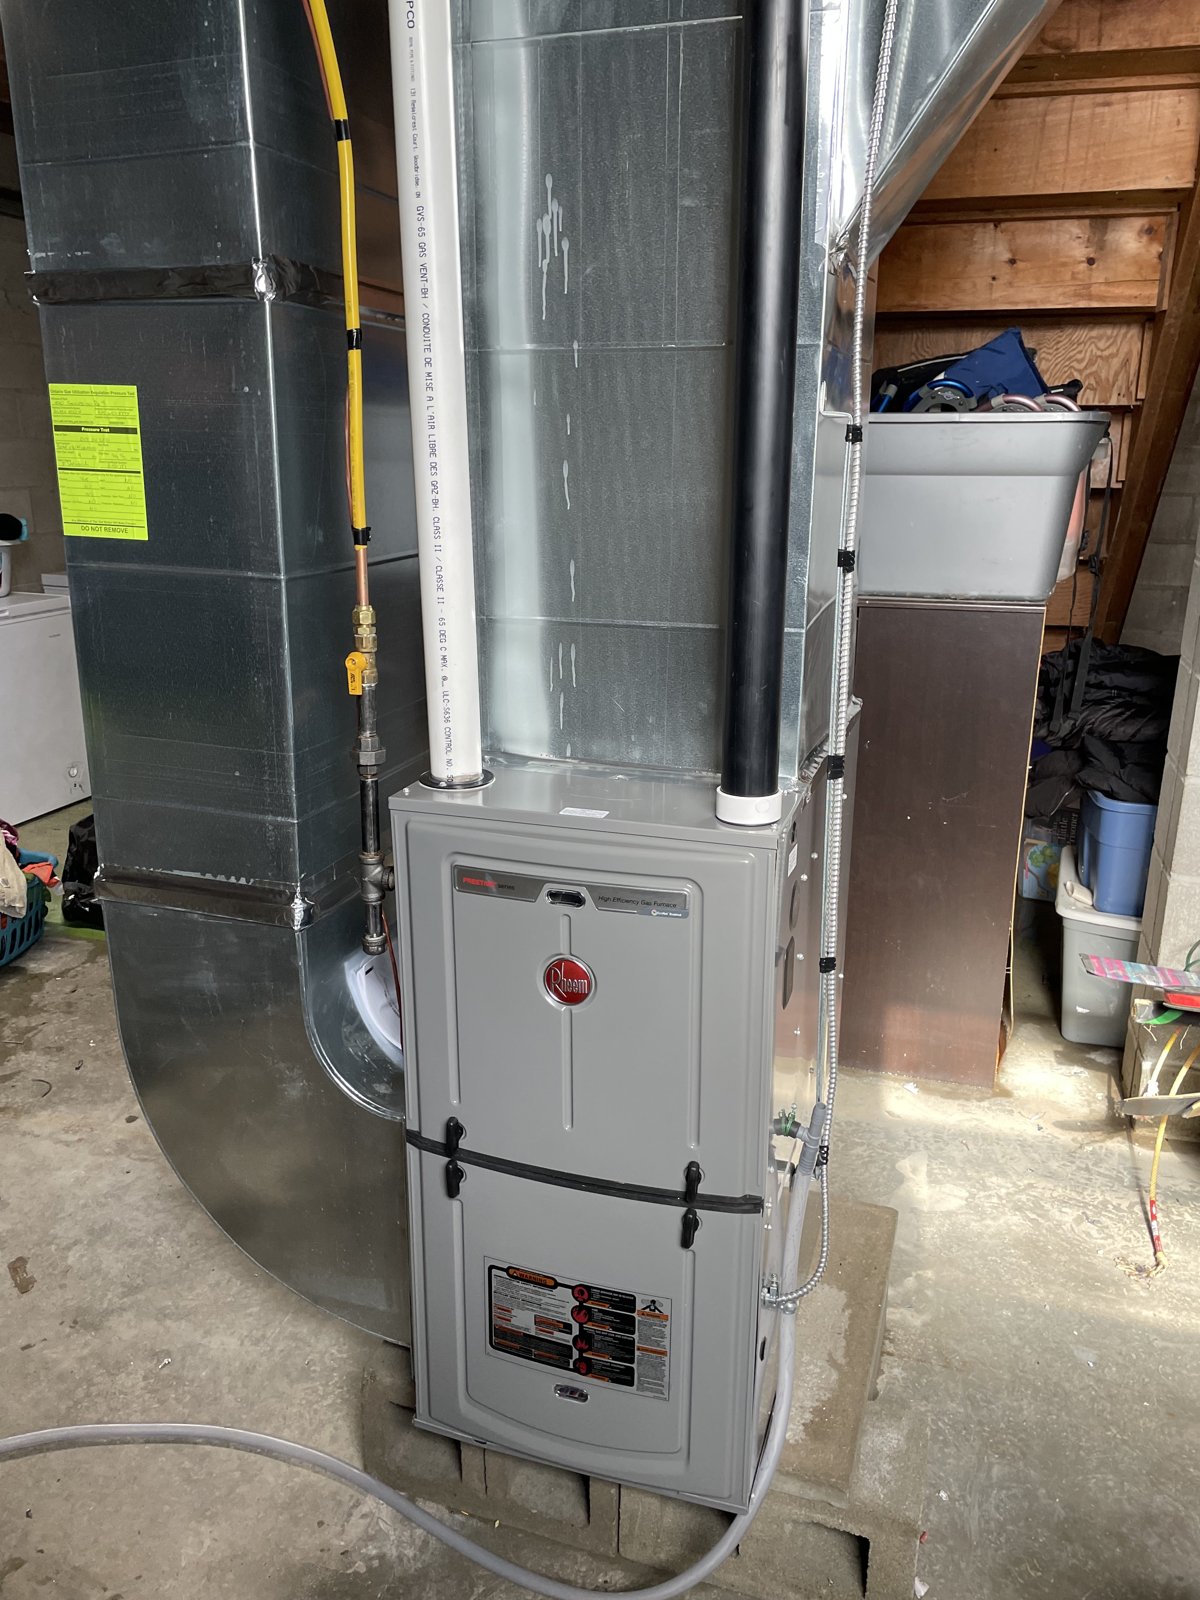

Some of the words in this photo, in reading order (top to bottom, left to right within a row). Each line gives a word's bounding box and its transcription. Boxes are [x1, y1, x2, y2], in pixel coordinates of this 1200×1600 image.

[406, 0, 415, 29] PCO
[417, 205, 425, 238] GVS-65
[418, 242, 426, 258] GAS
[420, 263, 428, 298] VENT-BH
[422, 313, 431, 353] CONDUITE
[424, 357, 432, 368] DE
[425, 372, 433, 392] MISE
[427, 405, 435, 430] L'AIR
[428, 434, 437, 458] LIBRE
[430, 462, 438, 476] DES
[104, 526, 129, 534] REMOVE
[433, 516, 441, 539] CLASS
[434, 544, 441, 552] II
[435, 565, 444, 592] CLASSE
[437, 596, 444, 604] II
[438, 617, 446, 626] 65
[439, 629, 447, 643] DEG
[440, 655, 448, 672] MAX.
[442, 690, 451, 724] ULC-S636
[444, 727, 453, 755] CONTROL
[598, 895, 612, 903] High
[612, 896, 640, 906] Efficiency
[653, 900, 677, 908] Furnace
[551, 962, 587, 998] Rheem
[518, 1272, 547, 1285] WARNING
